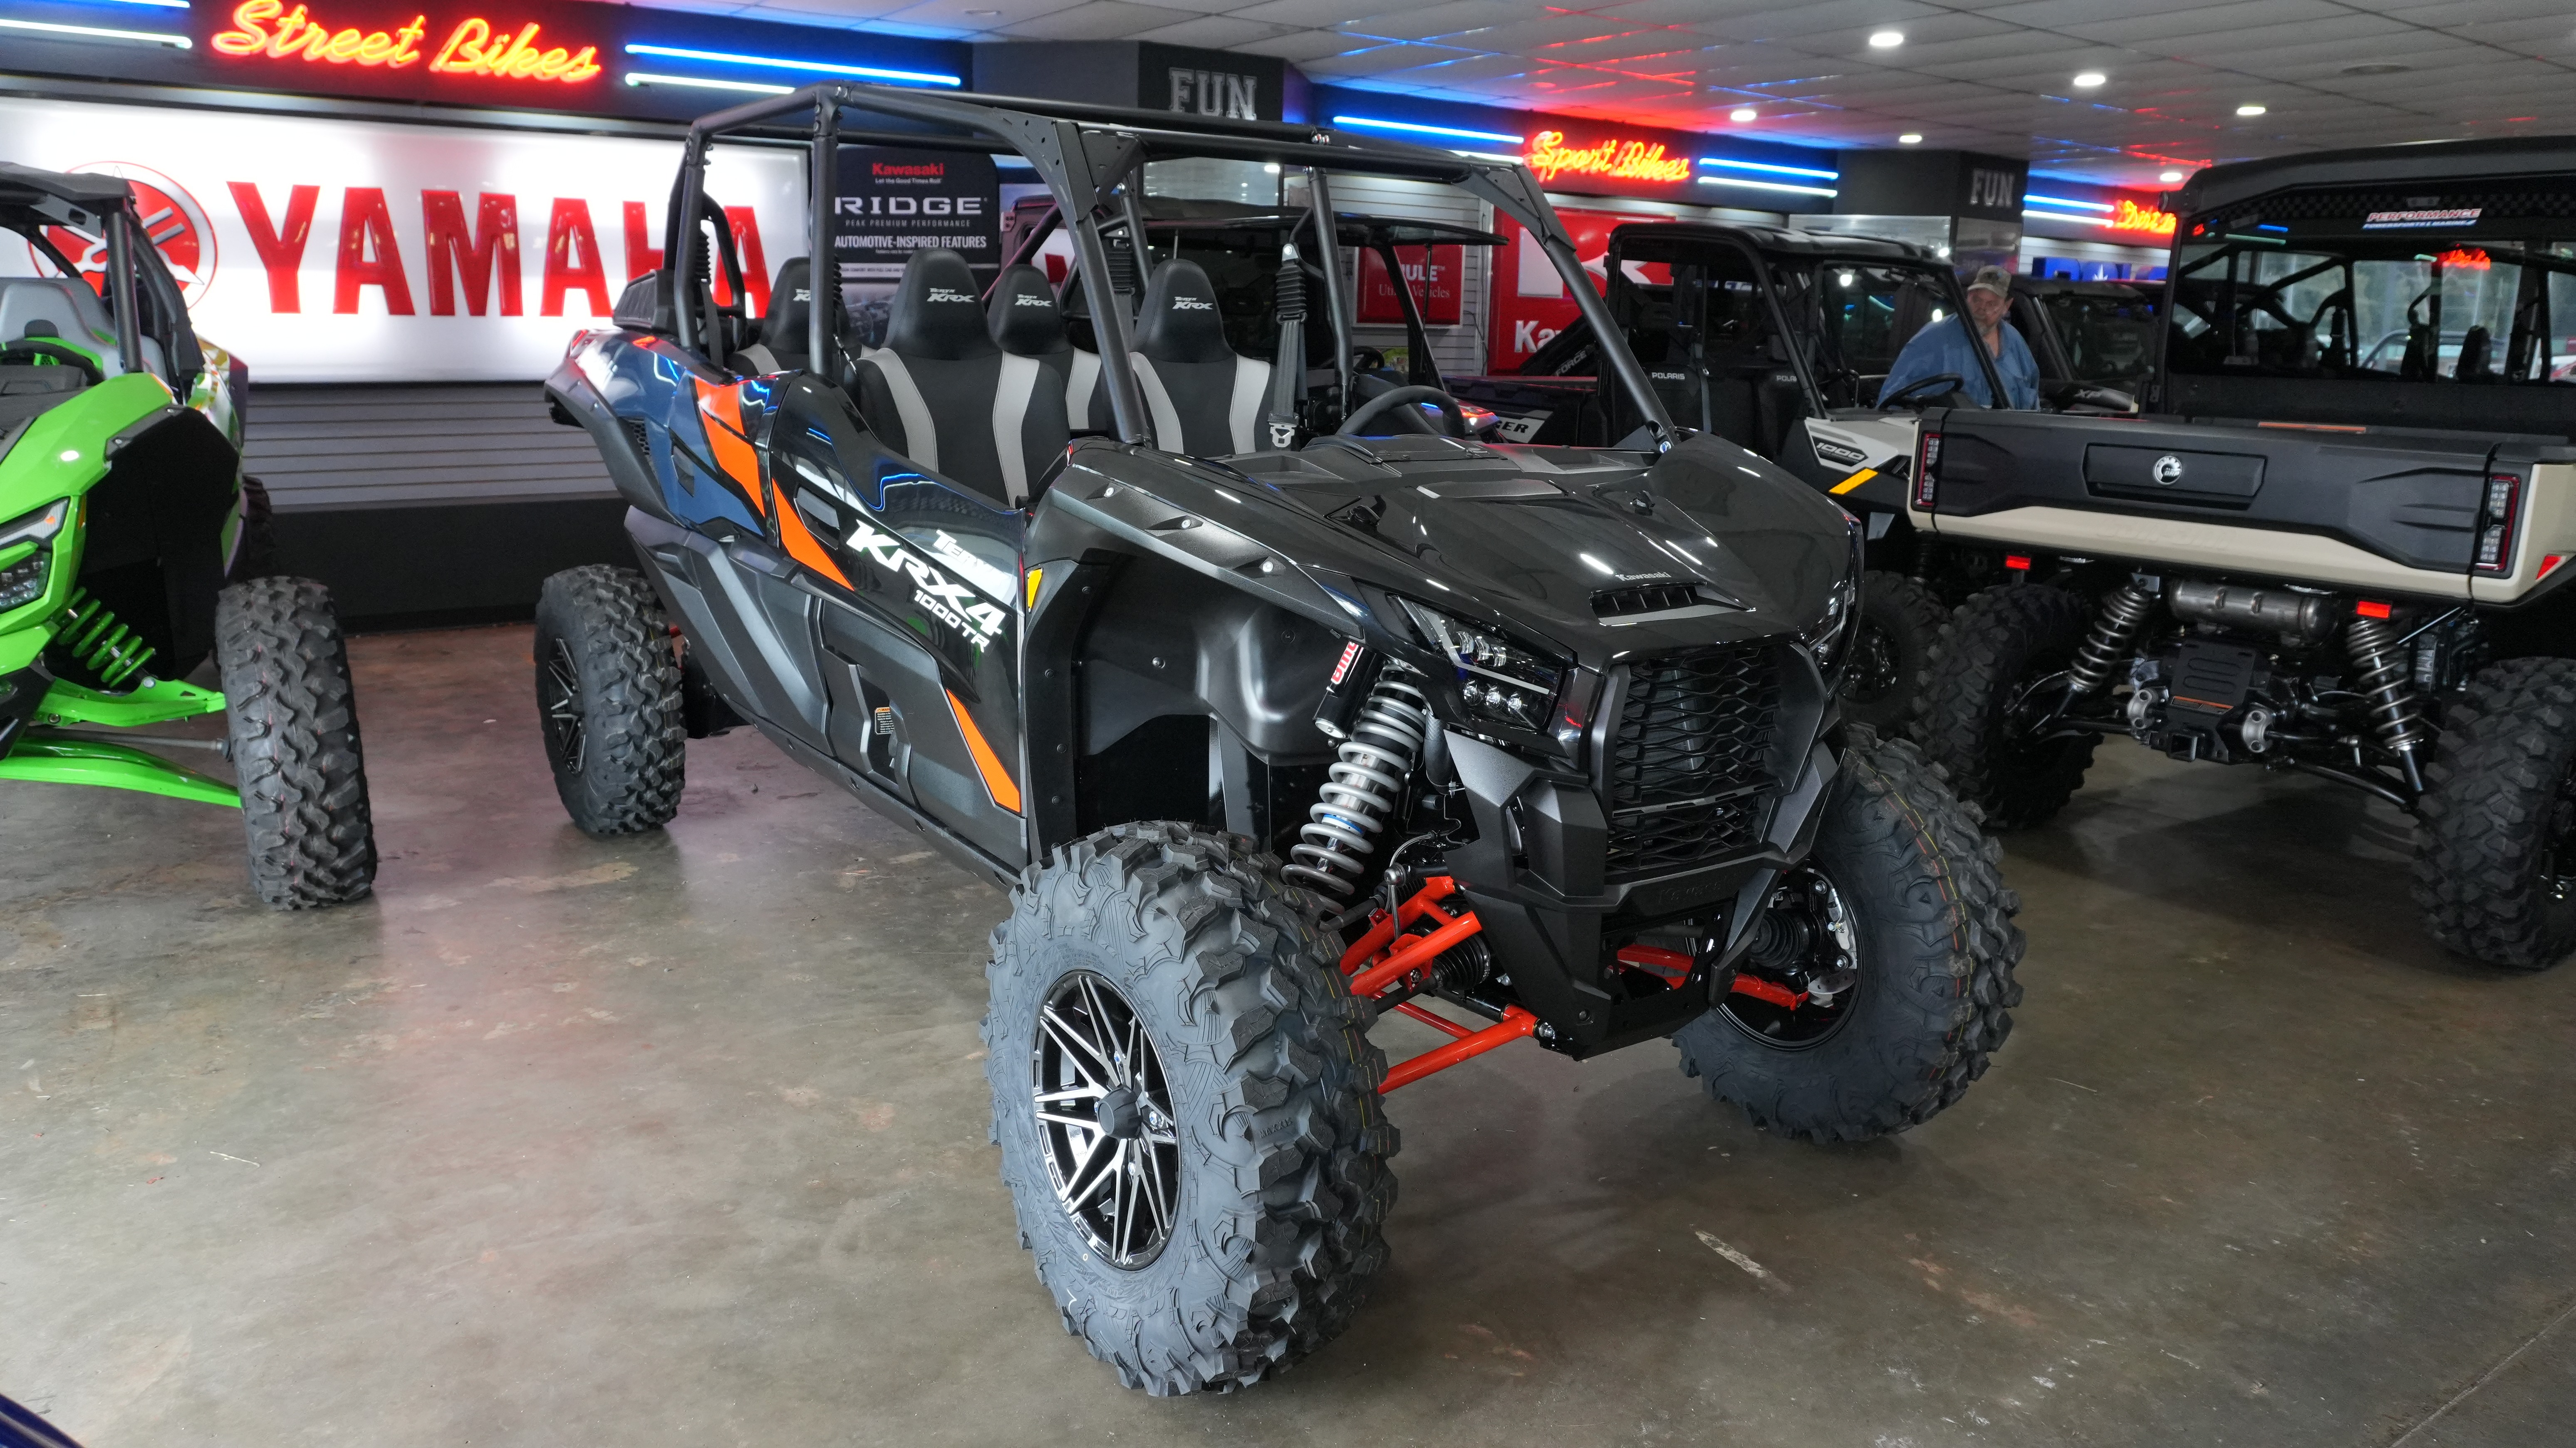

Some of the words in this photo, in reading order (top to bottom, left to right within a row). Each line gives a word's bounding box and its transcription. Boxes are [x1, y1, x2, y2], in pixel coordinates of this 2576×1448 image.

[211, 0, 426, 68] Street
[429, 17, 600, 82] Bikes
[1169, 67, 1257, 121] FUN
[1532, 131, 1617, 182] Sport
[1614, 141, 1690, 181] Bikes
[872, 163, 944, 175] Kawasaki
[1970, 169, 2015, 207] FUN
[2367, 208, 2482, 222] PERFORMANCE
[834, 236, 939, 248] AUTOMOTIVE-INSPIRED
[941, 236, 987, 248] FEATURES
[926, 293, 975, 302] KRX
[1412, 284, 1450, 298] Veicles
[1014, 298, 1052, 307] KRX
[1172, 301, 1214, 310] KRX
[1816, 442, 1865, 460] 1000
[1615, 572, 1672, 581] Kawasaki
